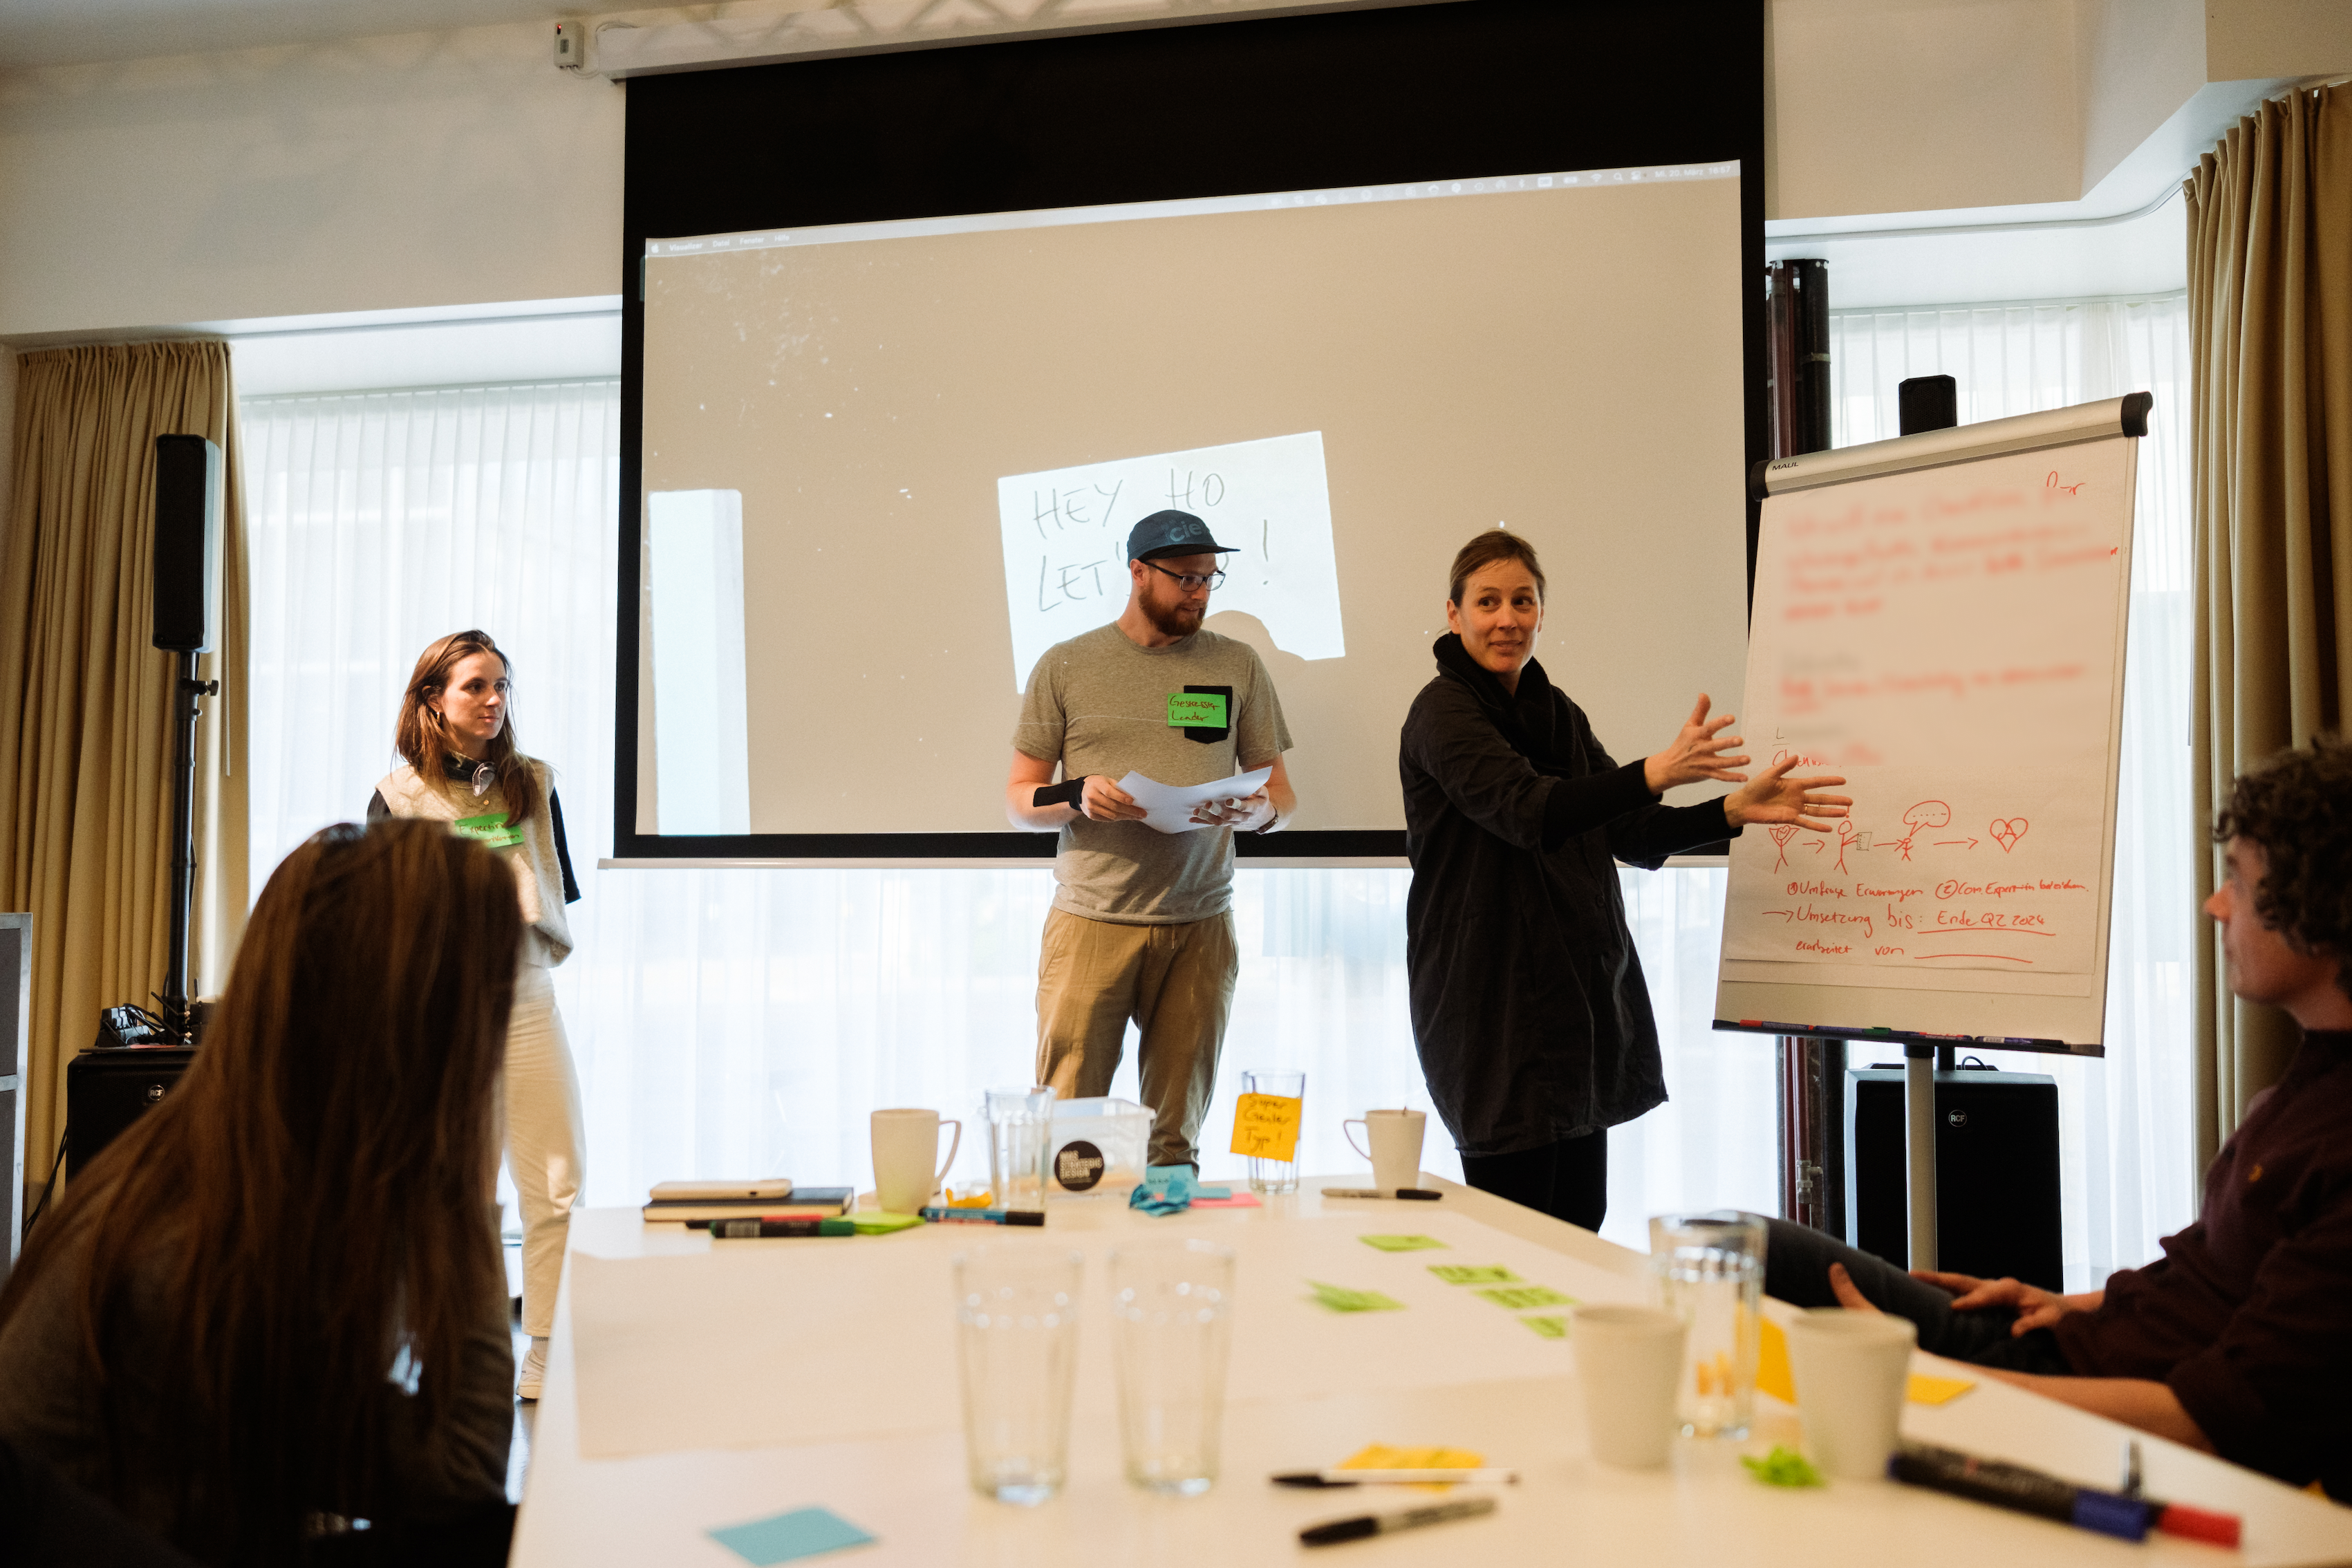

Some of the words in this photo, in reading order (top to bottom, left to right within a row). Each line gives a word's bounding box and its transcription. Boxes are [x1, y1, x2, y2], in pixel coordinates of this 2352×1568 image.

[669, 242, 703, 252] Visualizer
[713, 239, 730, 248] Datei
[1772, 462, 1799, 471] MAUL
[1034, 479, 1123, 540] HEY
[1164, 468, 1225, 510] HO
[1038, 541, 1130, 612] LET'
[1798, 904, 1873, 938] Umsetzung
[1938, 910, 1979, 926] Ende
[2012, 914, 2045, 926] 2024
[1796, 939, 1853, 955] erarbeitet
[1875, 946, 1904, 955] von
[1059, 1168, 1090, 1179] DESIGN
